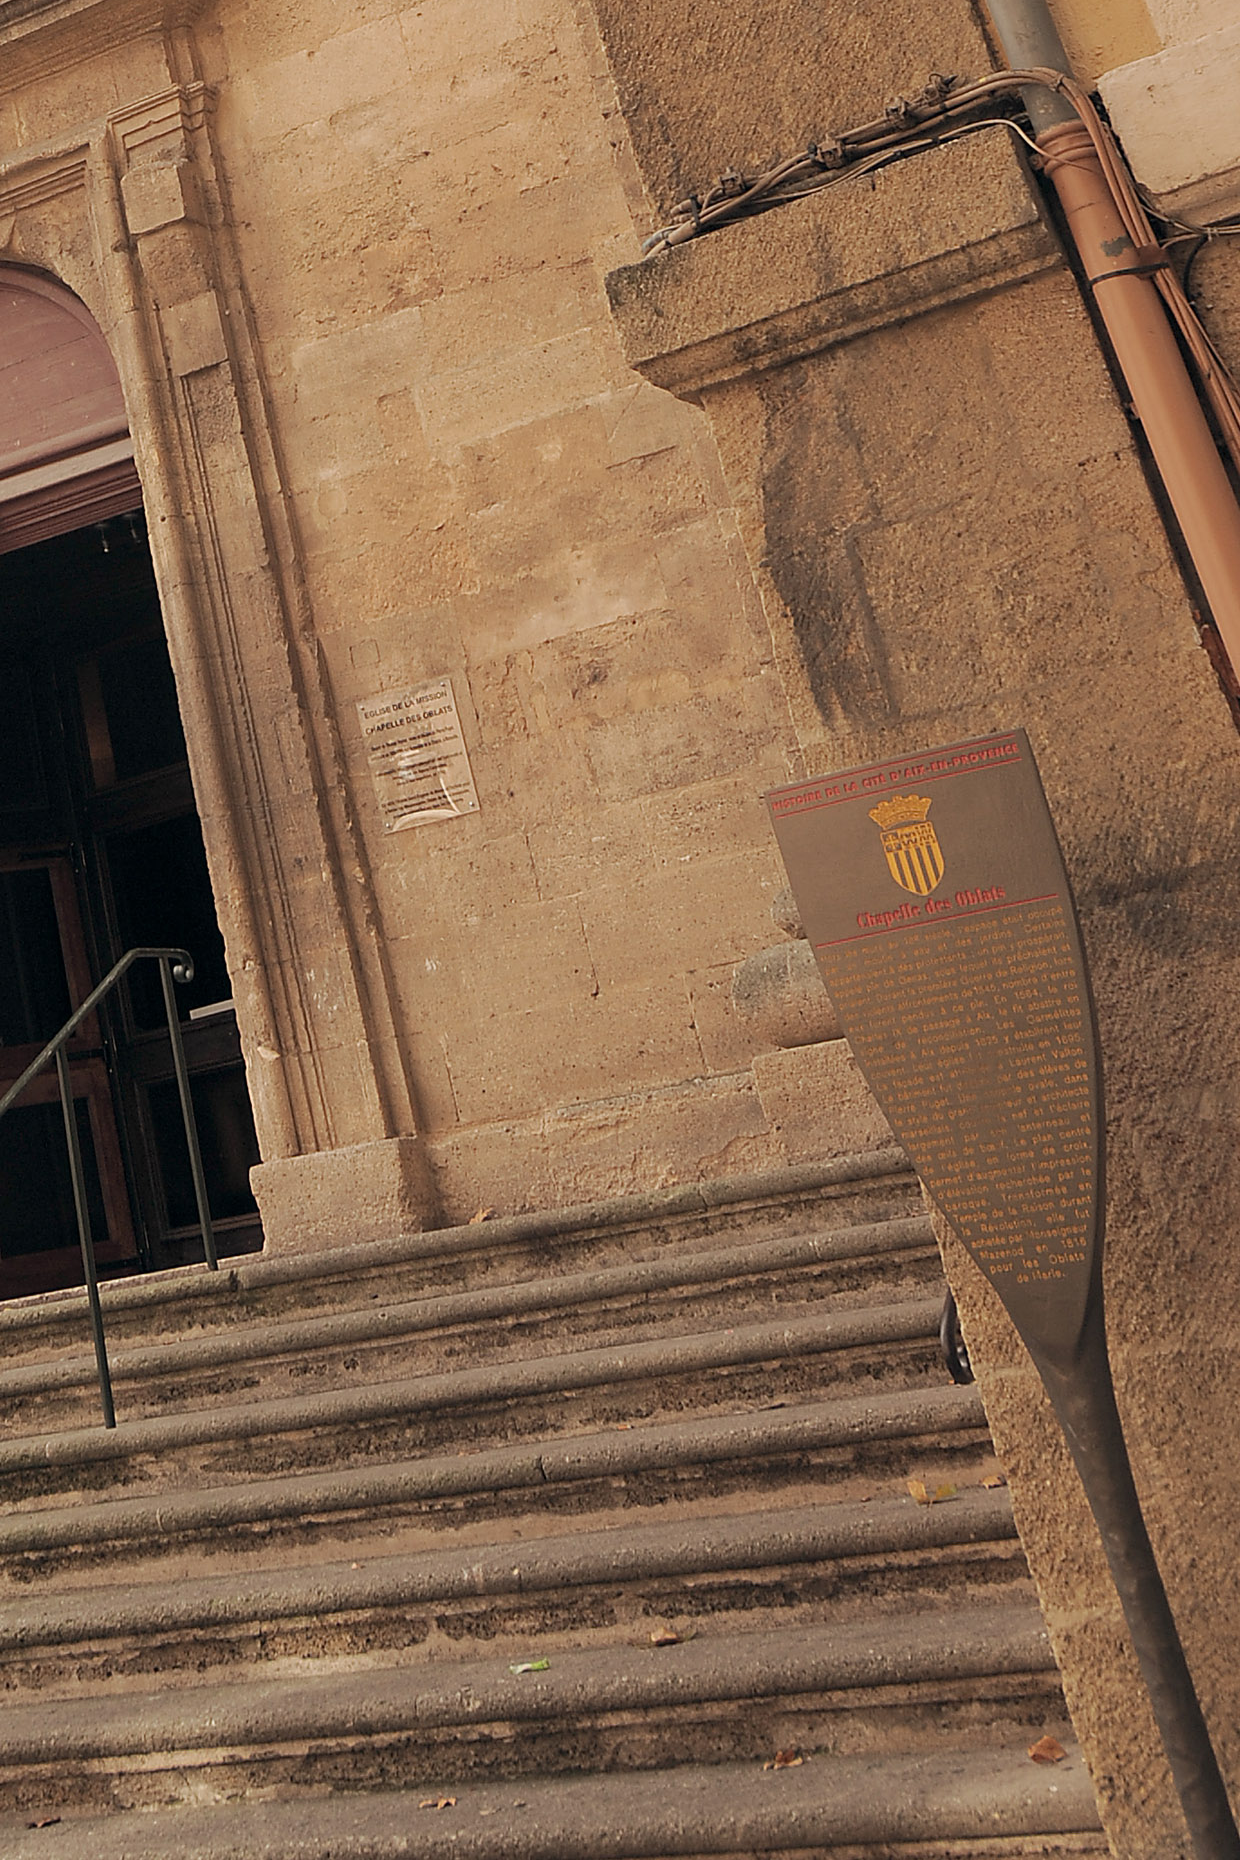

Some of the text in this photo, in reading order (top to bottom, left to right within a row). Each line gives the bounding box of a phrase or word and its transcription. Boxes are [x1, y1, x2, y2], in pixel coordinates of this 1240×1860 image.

[364, 690, 447, 719] EGLISE DE LA MISSION
[365, 704, 454, 735] CHAPELLE DES OBLATS
[772, 792, 822, 811] HISTOIRE
[826, 786, 841, 798] DE
[844, 781, 859, 793] LA
[862, 773, 887, 789] CITÉ
[856, 886, 1006, 929] Chapelle des Oblats
